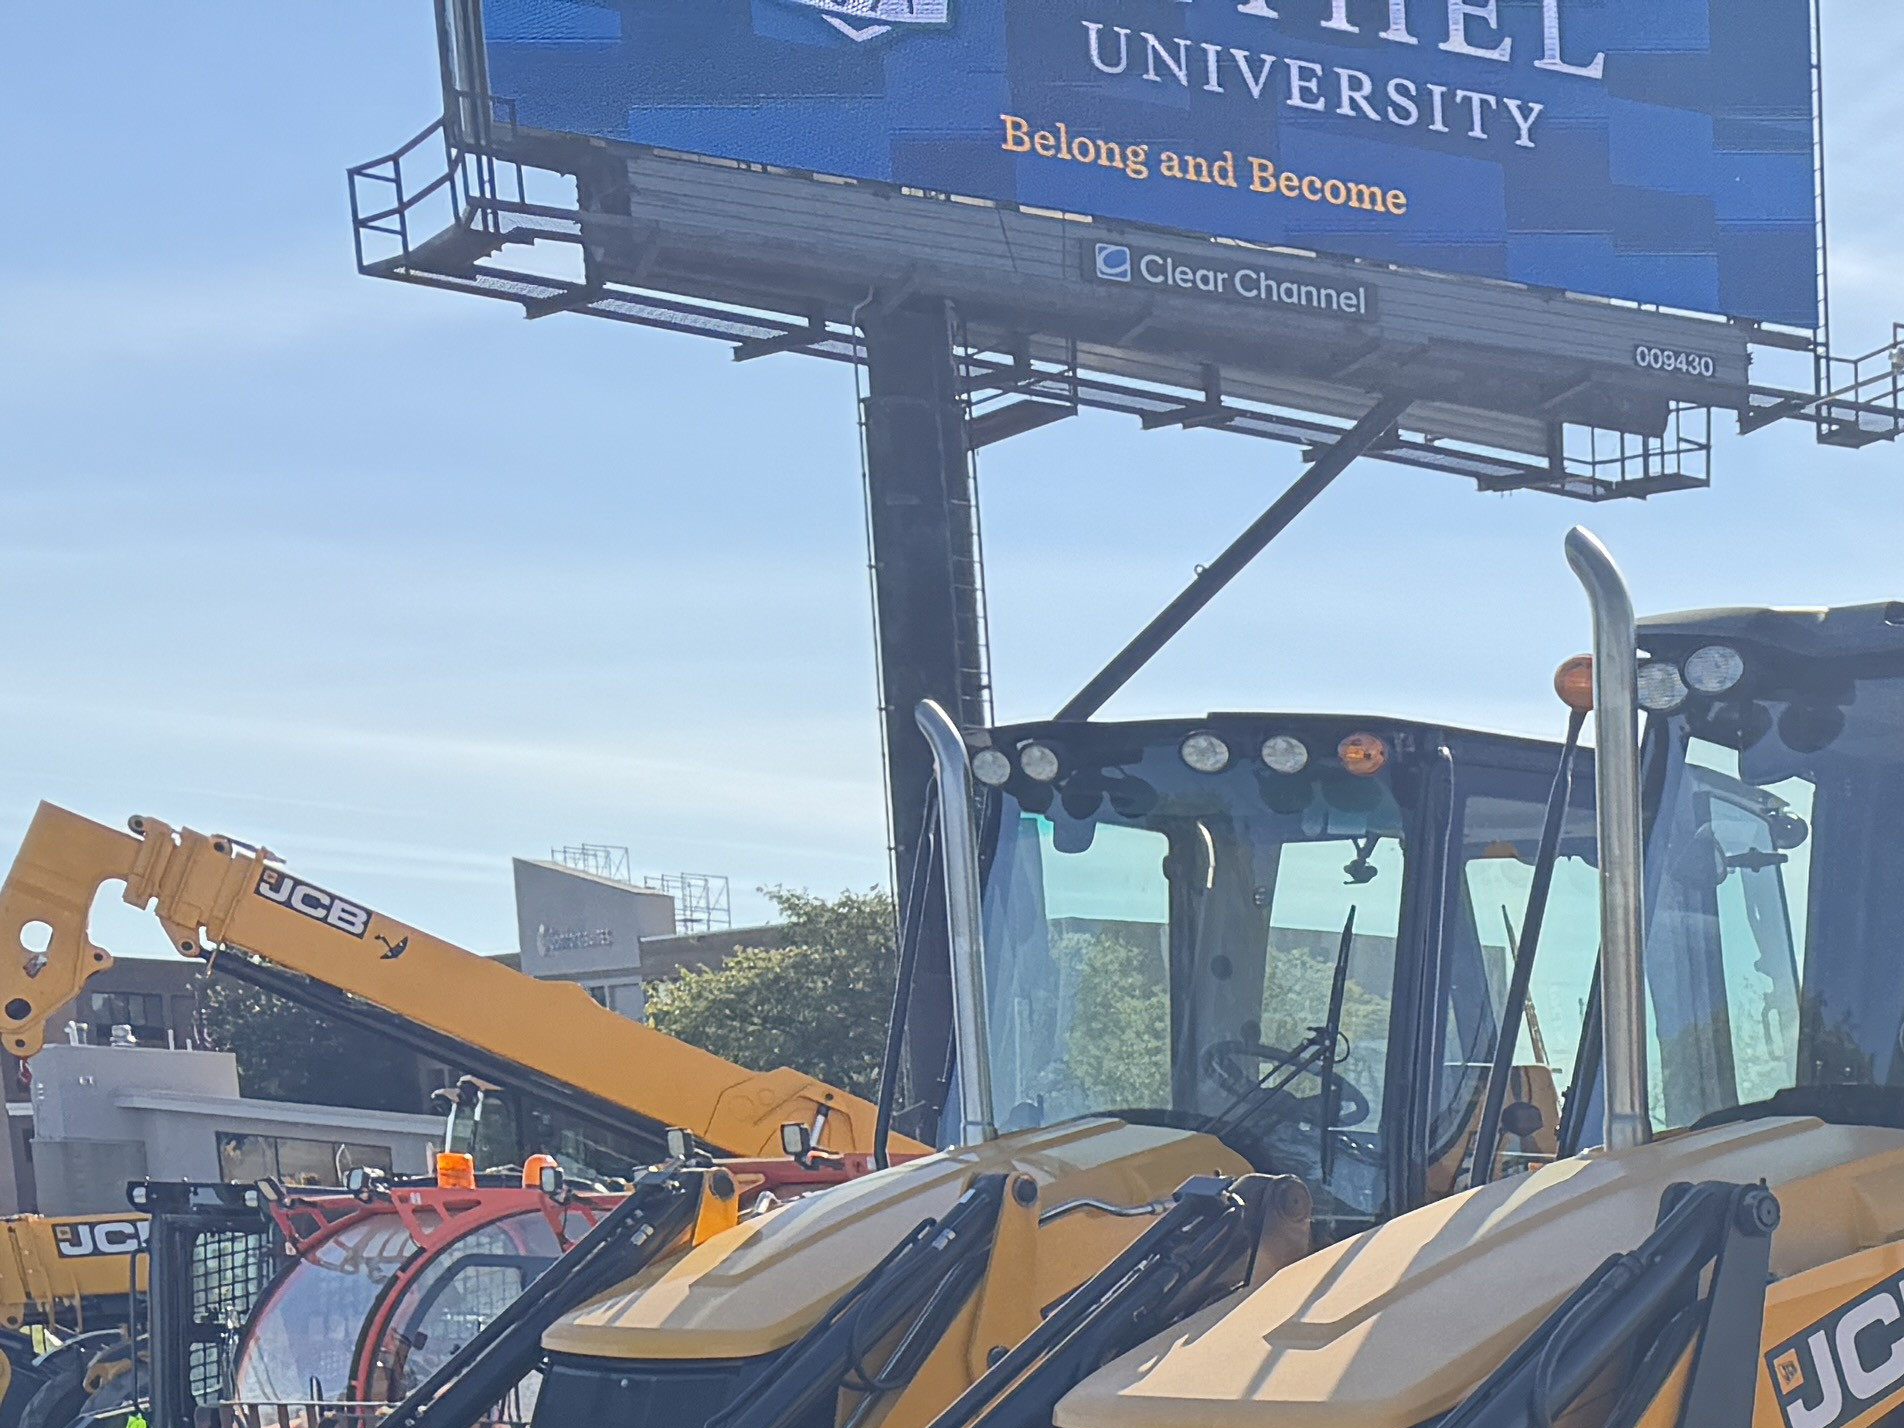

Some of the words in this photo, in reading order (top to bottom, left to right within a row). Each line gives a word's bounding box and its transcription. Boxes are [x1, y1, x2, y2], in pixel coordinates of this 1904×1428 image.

[1081, 20, 1545, 148] UNIVERSITY
[1001, 114, 1148, 179] Belong
[1160, 148, 1237, 188] and
[1248, 157, 1408, 215] Become
[1139, 253, 1230, 296] Clear
[1234, 267, 1367, 315] Channel
[1635, 345, 1715, 378] 009430
[259, 877, 368, 935] JCB
